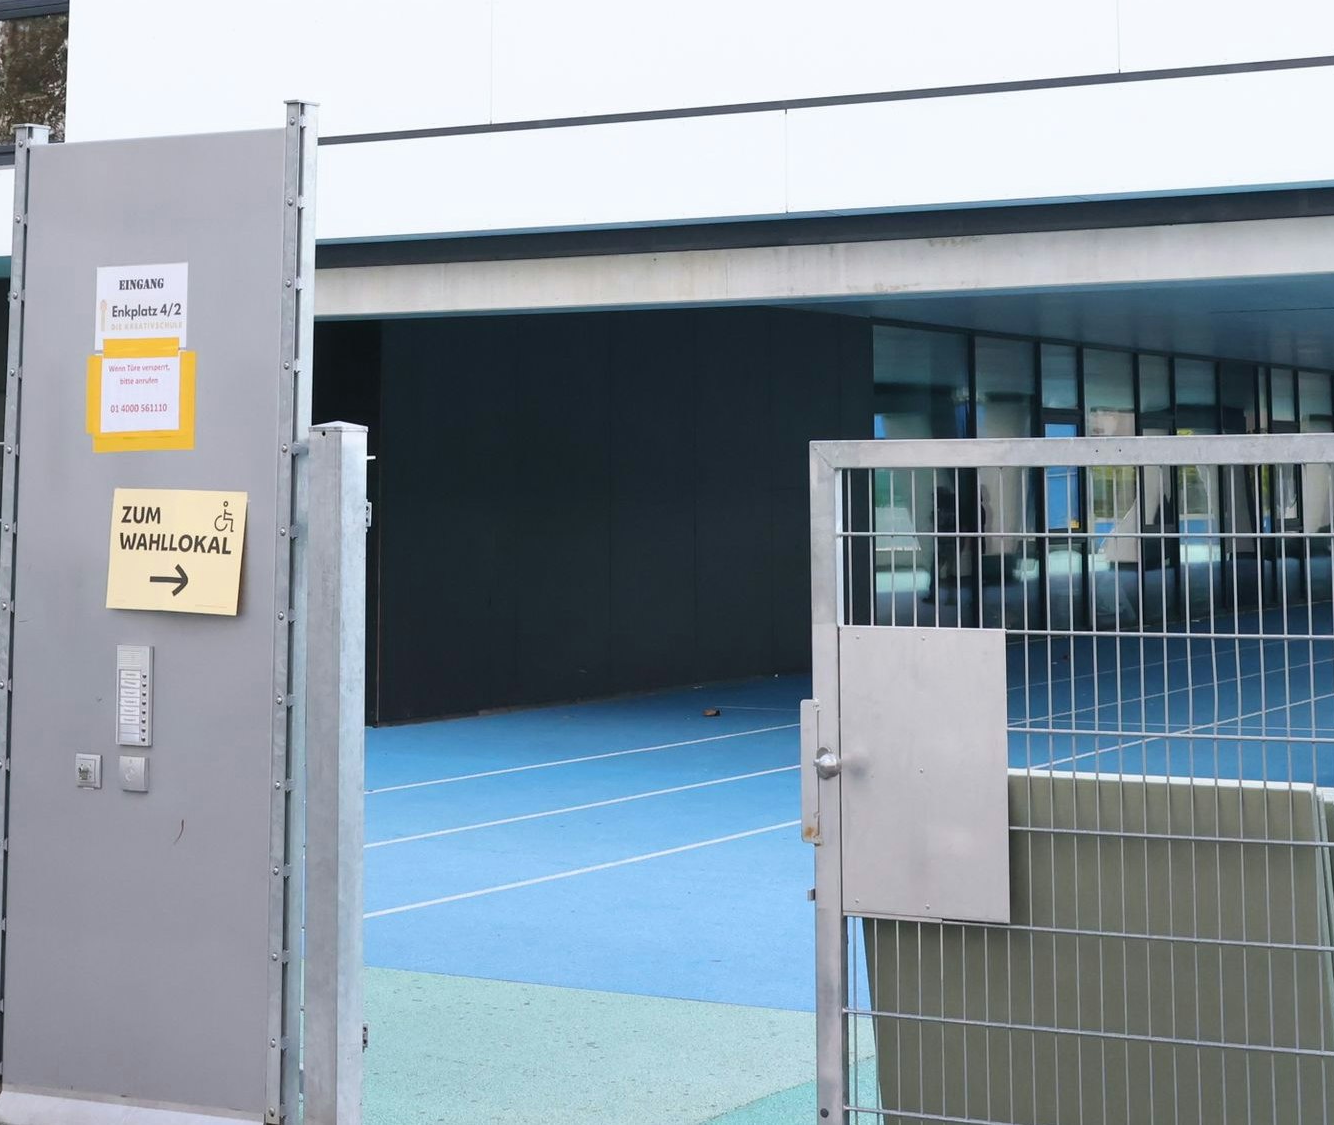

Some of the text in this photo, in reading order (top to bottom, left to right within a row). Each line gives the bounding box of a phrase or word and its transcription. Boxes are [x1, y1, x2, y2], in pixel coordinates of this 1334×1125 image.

[119, 278, 164, 290] EINGANG
[112, 303, 181, 320] Enkplatz 4/2
[127, 364, 141, 372] Türe
[120, 377, 158, 385] bitte anrufen
[110, 403, 167, 413] 01 4000 561110
[121, 506, 160, 524] ZUM
[119, 532, 231, 555] WAHLLOKAL
